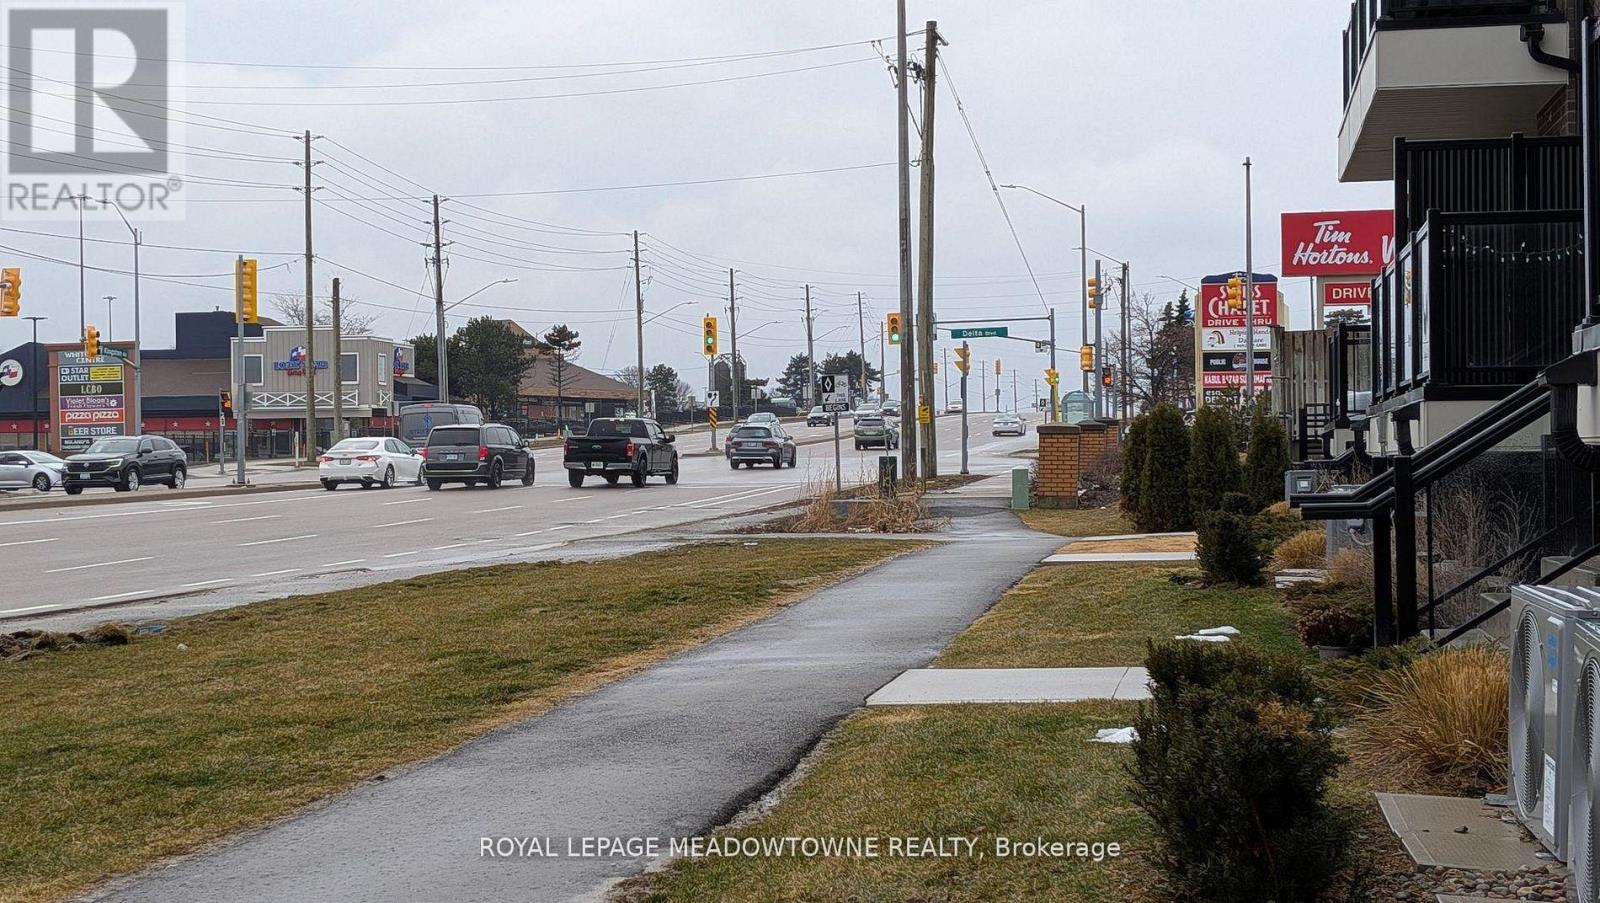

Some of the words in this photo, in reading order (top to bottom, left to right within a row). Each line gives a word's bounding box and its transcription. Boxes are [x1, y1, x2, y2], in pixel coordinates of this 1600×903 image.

[1313, 219, 1352, 244] Tim
[1207, 319, 1239, 327] DRIVE
[80, 385, 103, 394] LCBO
[65, 411, 91, 422] pizza
[92, 411, 119, 421] pizza
[90, 427, 117, 435] STORE
